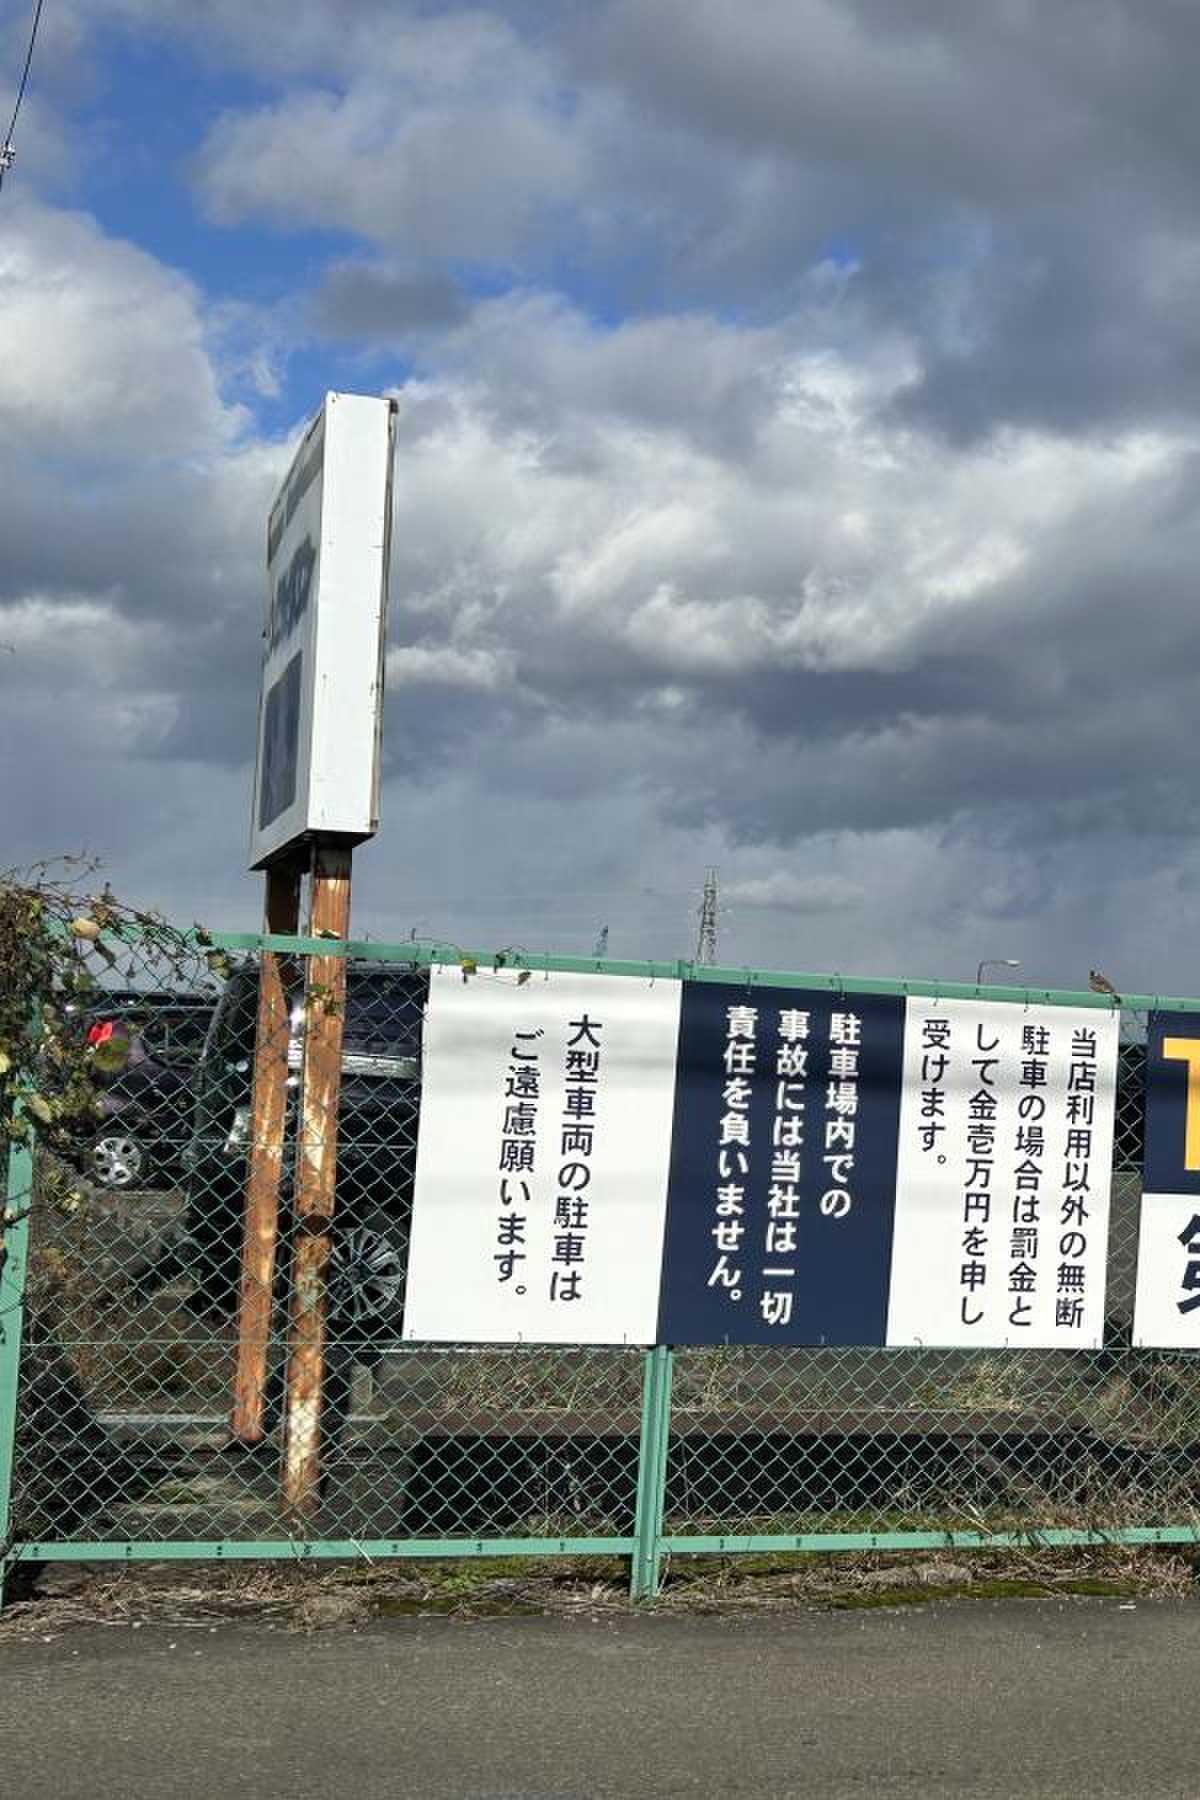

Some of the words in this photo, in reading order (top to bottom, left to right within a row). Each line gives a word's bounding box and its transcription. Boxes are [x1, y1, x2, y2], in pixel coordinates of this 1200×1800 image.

[494, 1028, 544, 1297] ご遠慮願います。
[549, 1014, 603, 1303] 大型車両の駐車は
[707, 1005, 758, 1302] 責任を負いません。
[760, 1009, 810, 1326] 事故には当社は一切
[820, 1012, 862, 1219] 駐車場内での
[918, 1019, 951, 1165] 受けます。
[959, 1023, 1000, 1326] して金壱万円を申し
[1008, 1025, 1050, 1327] 駐車の場合は罰金と
[1055, 1029, 1097, 1328] 当店利用以外の無断
